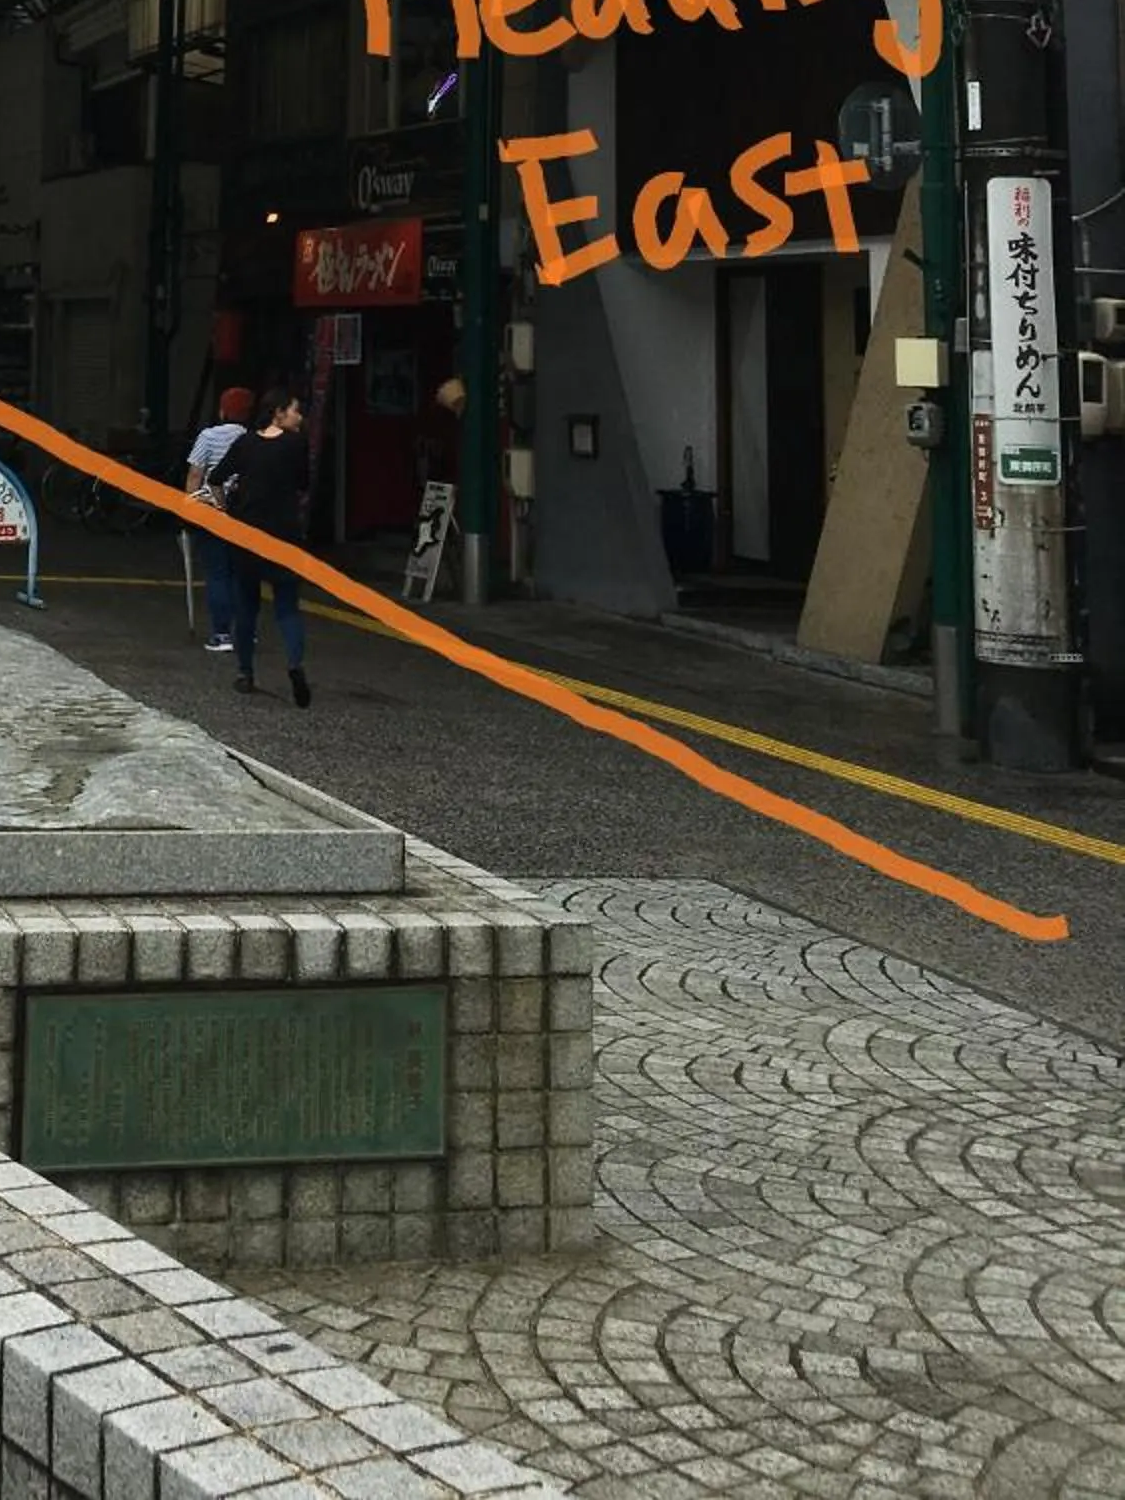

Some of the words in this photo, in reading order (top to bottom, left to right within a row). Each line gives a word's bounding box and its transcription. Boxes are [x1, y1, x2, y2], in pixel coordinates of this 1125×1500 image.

[1005, 232, 1041, 399] 味付ちりめん
